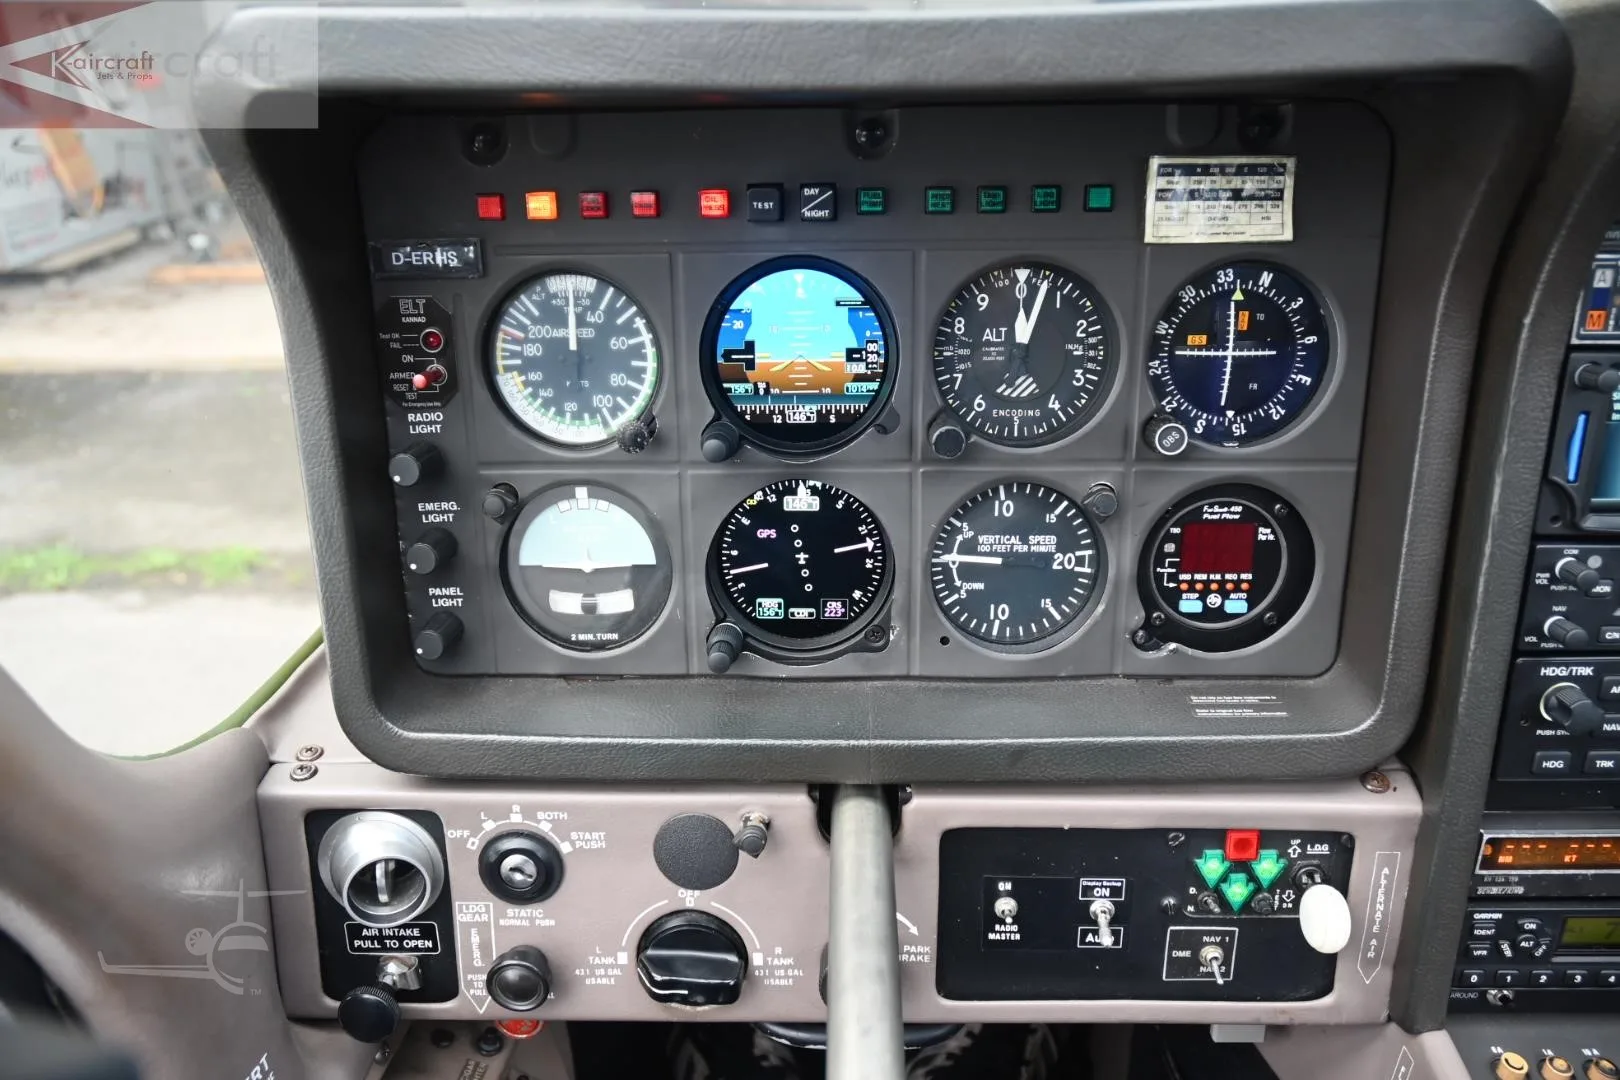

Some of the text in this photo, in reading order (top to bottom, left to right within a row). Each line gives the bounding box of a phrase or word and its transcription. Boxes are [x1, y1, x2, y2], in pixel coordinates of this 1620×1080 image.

[804, 187, 820, 196] DAY
[752, 201, 774, 210] TEST
[804, 209, 830, 218] NIGHT
[1216, 268, 1234, 283] 33
[1258, 270, 1273, 288] N
[1178, 284, 1196, 303] 30
[399, 298, 426, 314] ELT
[976, 293, 989, 312] 9
[1291, 297, 1304, 310] 3
[586, 310, 604, 323] 40
[1256, 313, 1265, 321] TO
[1588, 313, 1602, 328] M
[732, 319, 744, 330] 20
[954, 316, 965, 335] 8
[1076, 319, 1087, 338] 2
[1155, 320, 1169, 336] W
[528, 325, 552, 338] 200
[552, 328, 595, 338] AIRSEED
[982, 327, 1008, 342] ALT
[609, 336, 628, 350] 60
[1190, 336, 1204, 345] GS
[1304, 335, 1318, 344] 6
[522, 343, 542, 357] 180
[401, 354, 414, 363] ON
[1148, 359, 1162, 376] 24
[389, 371, 416, 380] ARMED
[527, 372, 543, 381] 160
[610, 373, 628, 386] 80
[1072, 369, 1085, 387] 3
[1296, 374, 1312, 386] E
[953, 373, 963, 391] 7
[405, 392, 417, 400] TEST
[538, 387, 554, 397] 140
[592, 394, 614, 408] 100
[973, 394, 986, 411] 6
[1048, 394, 1061, 411] 4
[1161, 396, 1178, 412] 21
[563, 402, 578, 412] 120
[407, 411, 444, 423] RADIO
[992, 409, 1041, 417] ENCODING
[1269, 405, 1286, 420] 12
[772, 414, 782, 423] 12
[1013, 417, 1020, 425] 5
[409, 424, 442, 434] LIGHT
[1194, 419, 1206, 434] S
[1232, 423, 1248, 437] 15
[1162, 431, 1181, 448] OBS
[418, 501, 461, 512] EMERG.
[766, 494, 845, 510] 12 S
[994, 500, 1015, 518] 10
[422, 513, 455, 523] LIGHT
[741, 516, 751, 526] E
[1045, 513, 1057, 524] 15
[858, 524, 868, 535] 21
[962, 522, 969, 532] 5
[756, 529, 777, 539] GPS
[963, 531, 975, 539] UP
[977, 535, 1057, 545] VERTICAL SPEED
[1030, 545, 1057, 553] MINUTE
[865, 558, 874, 569] 24
[1052, 553, 1076, 570] 20
[962, 582, 985, 590] DOWN
[428, 587, 464, 596] PANEL
[960, 589, 967, 599] 5
[432, 598, 464, 608] LIGHT
[761, 601, 779, 609] HDG
[826, 601, 842, 609] CRS
[1040, 598, 1052, 608] 15
[989, 603, 1010, 621] 10
[571, 633, 577, 641] 2
[1540, 666, 1594, 677] HDG/TRK
[1542, 760, 1565, 768] HDG
[1595, 760, 1615, 768] TRK
[511, 804, 521, 813] R
[480, 812, 488, 820] L
[536, 812, 568, 820] BOTH
[447, 830, 471, 839] OFF
[570, 831, 606, 841] START
[575, 840, 606, 849] PUSH
[997, 882, 1012, 891] ON
[677, 890, 701, 898] OFF
[1093, 888, 1110, 897] ON
[463, 904, 486, 913] LDG
[506, 909, 544, 918] STATIC
[458, 913, 489, 922] GEAR
[1473, 912, 1503, 920] GARMIN
[499, 918, 531, 926] NORMAL
[361, 928, 421, 937] AIR INTAKE
[995, 924, 1018, 932] RADIO
[1473, 928, 1496, 936] IDENT
[988, 932, 1021, 941] MASTER
[1202, 935, 1222, 943] NAV
[354, 940, 433, 949] PULL TO OPEN
[903, 945, 931, 953] PARK
[1367, 938, 1377, 959] AIR
[1519, 940, 1534, 948] ALT
[775, 947, 782, 955] R
[1172, 950, 1192, 958] DME
[588, 956, 616, 965] TANK
[766, 957, 794, 966] TANK
[595, 968, 622, 976] US GAL
[788, 969, 803, 977] GAL
[764, 978, 793, 986] USABLE
[1470, 974, 1616, 983] 0 1 2 3 4
